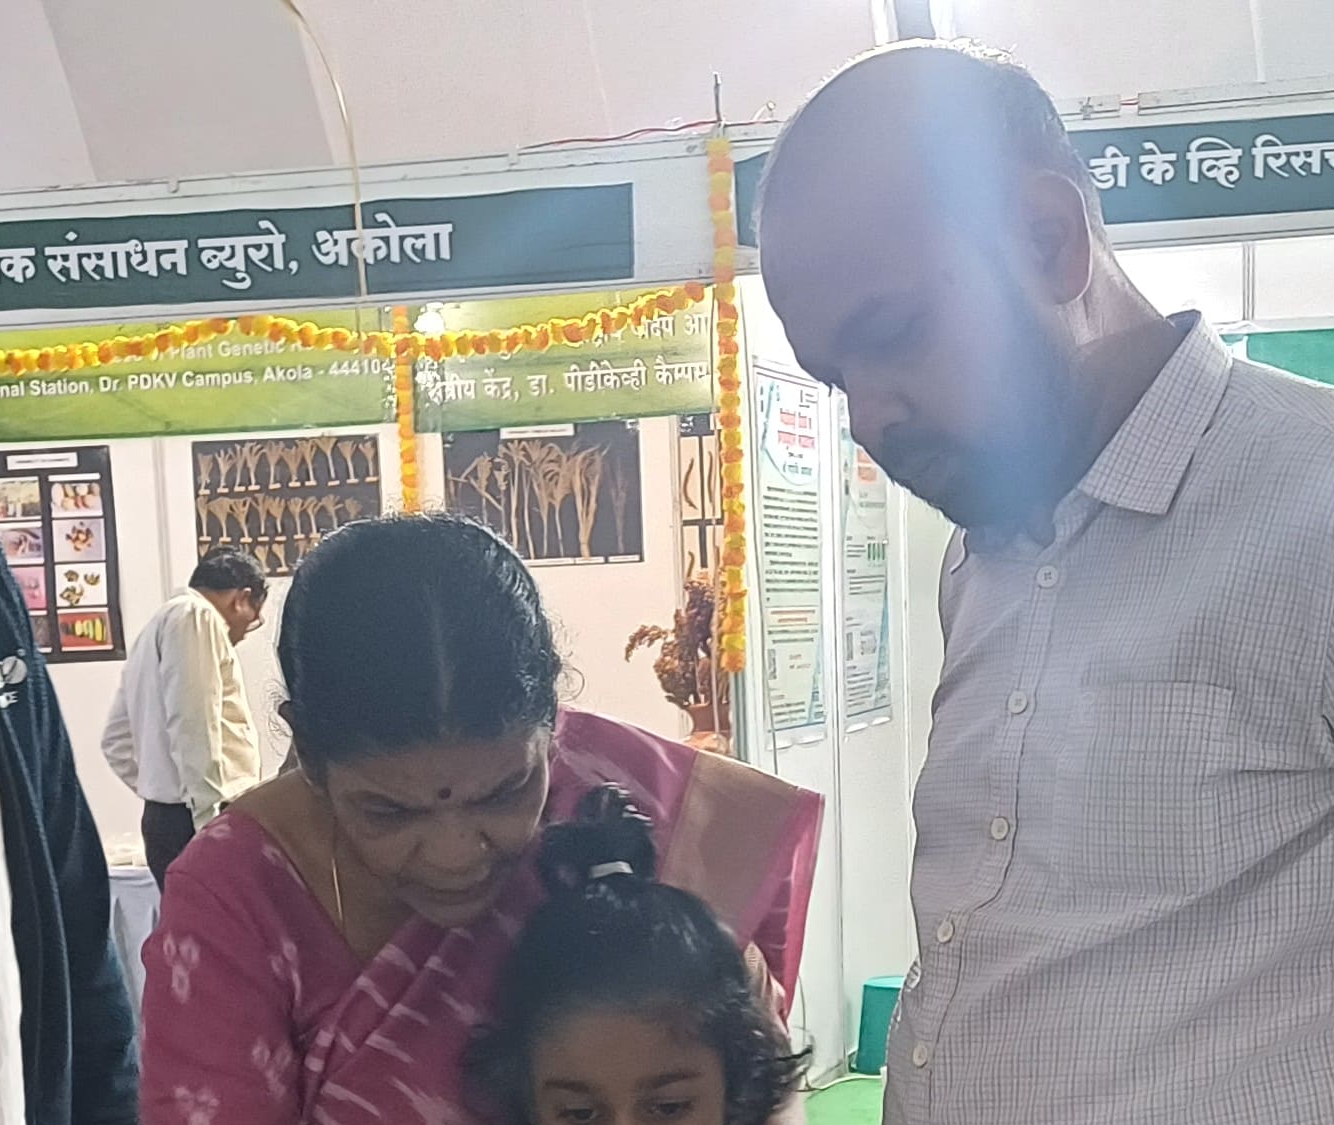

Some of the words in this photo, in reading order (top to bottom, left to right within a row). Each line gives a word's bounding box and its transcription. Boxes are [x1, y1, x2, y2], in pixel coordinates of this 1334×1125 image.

[1139, 142, 1177, 185] के
[1186, 137, 1242, 188] व्हि
[45, 231, 187, 283] संसाधन
[312, 213, 453, 266] अकोला
[30, 376, 94, 397] Station,
[128, 372, 178, 391] PDKV
[182, 368, 259, 389] Campus,
[264, 365, 313, 383] Akola
